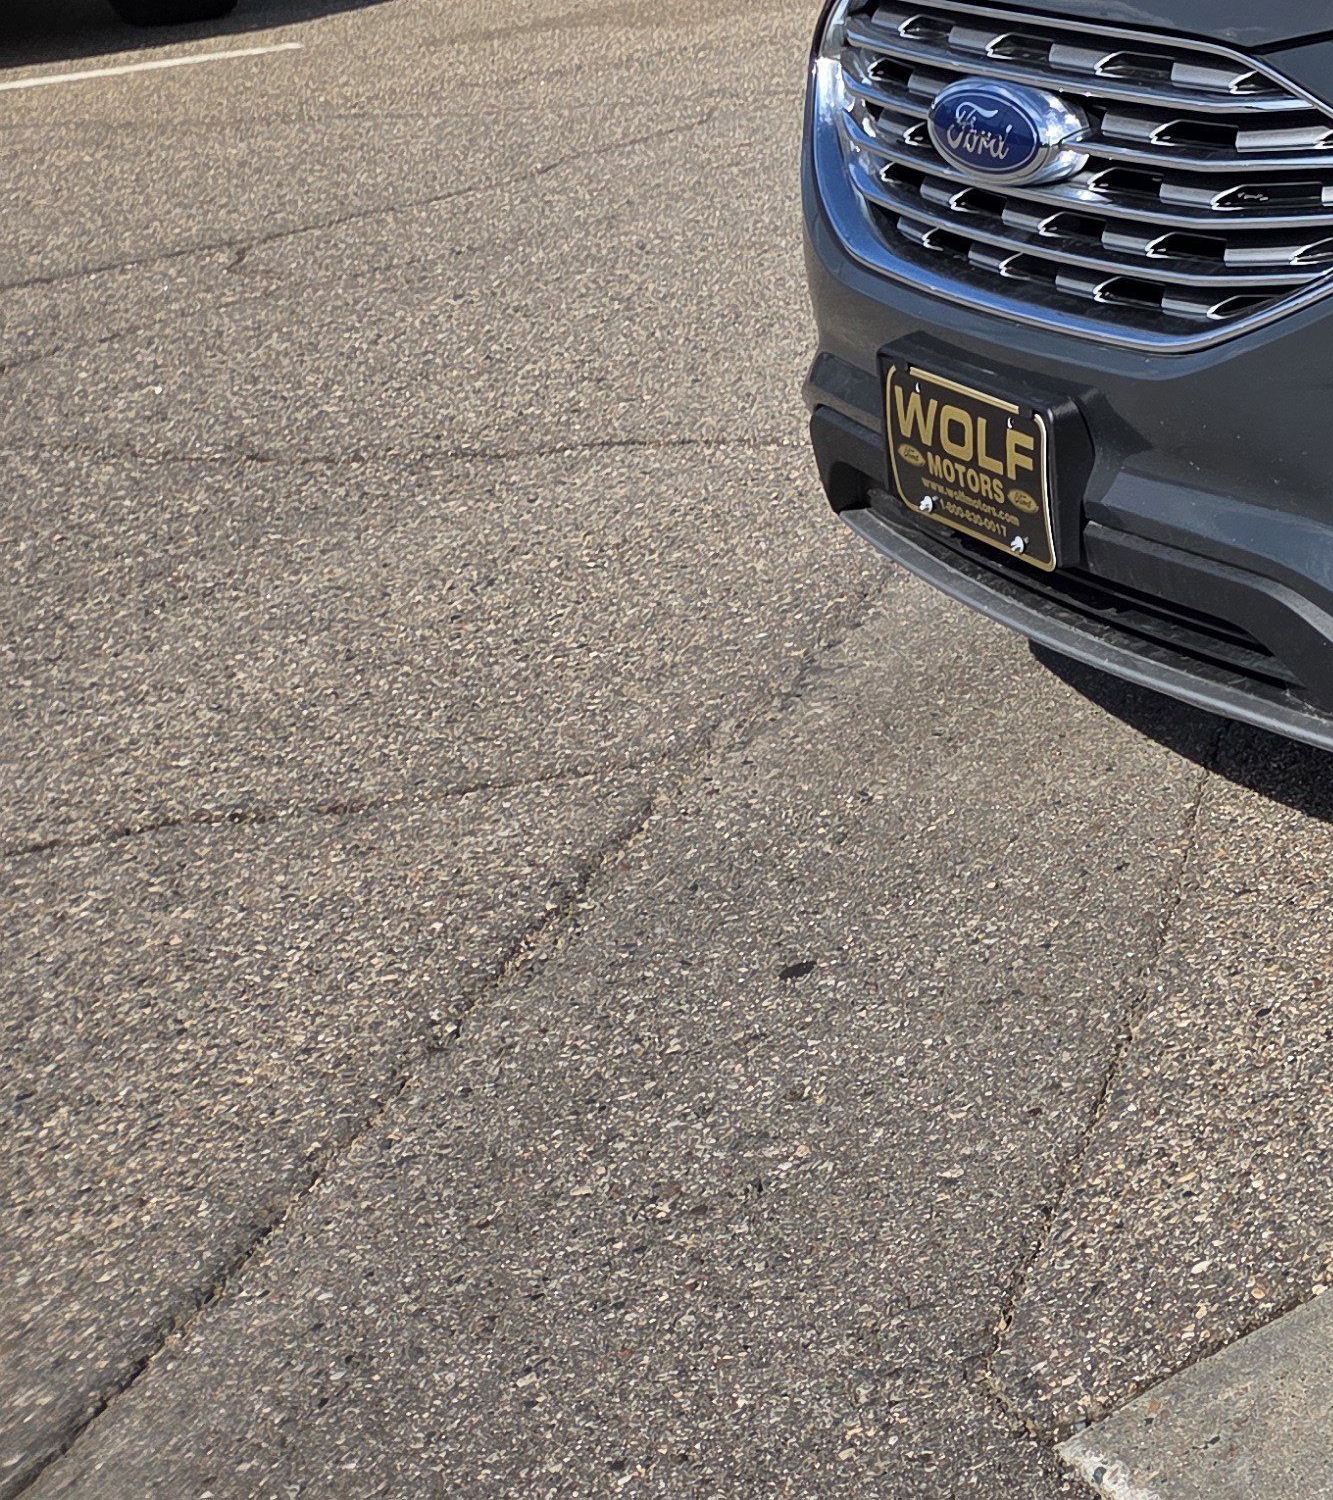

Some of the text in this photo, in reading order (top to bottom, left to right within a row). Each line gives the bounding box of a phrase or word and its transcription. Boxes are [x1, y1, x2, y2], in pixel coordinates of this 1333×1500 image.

[947, 101, 1013, 160] Ford
[894, 385, 1034, 481] WOLF
[927, 451, 1005, 504] MOTORS
